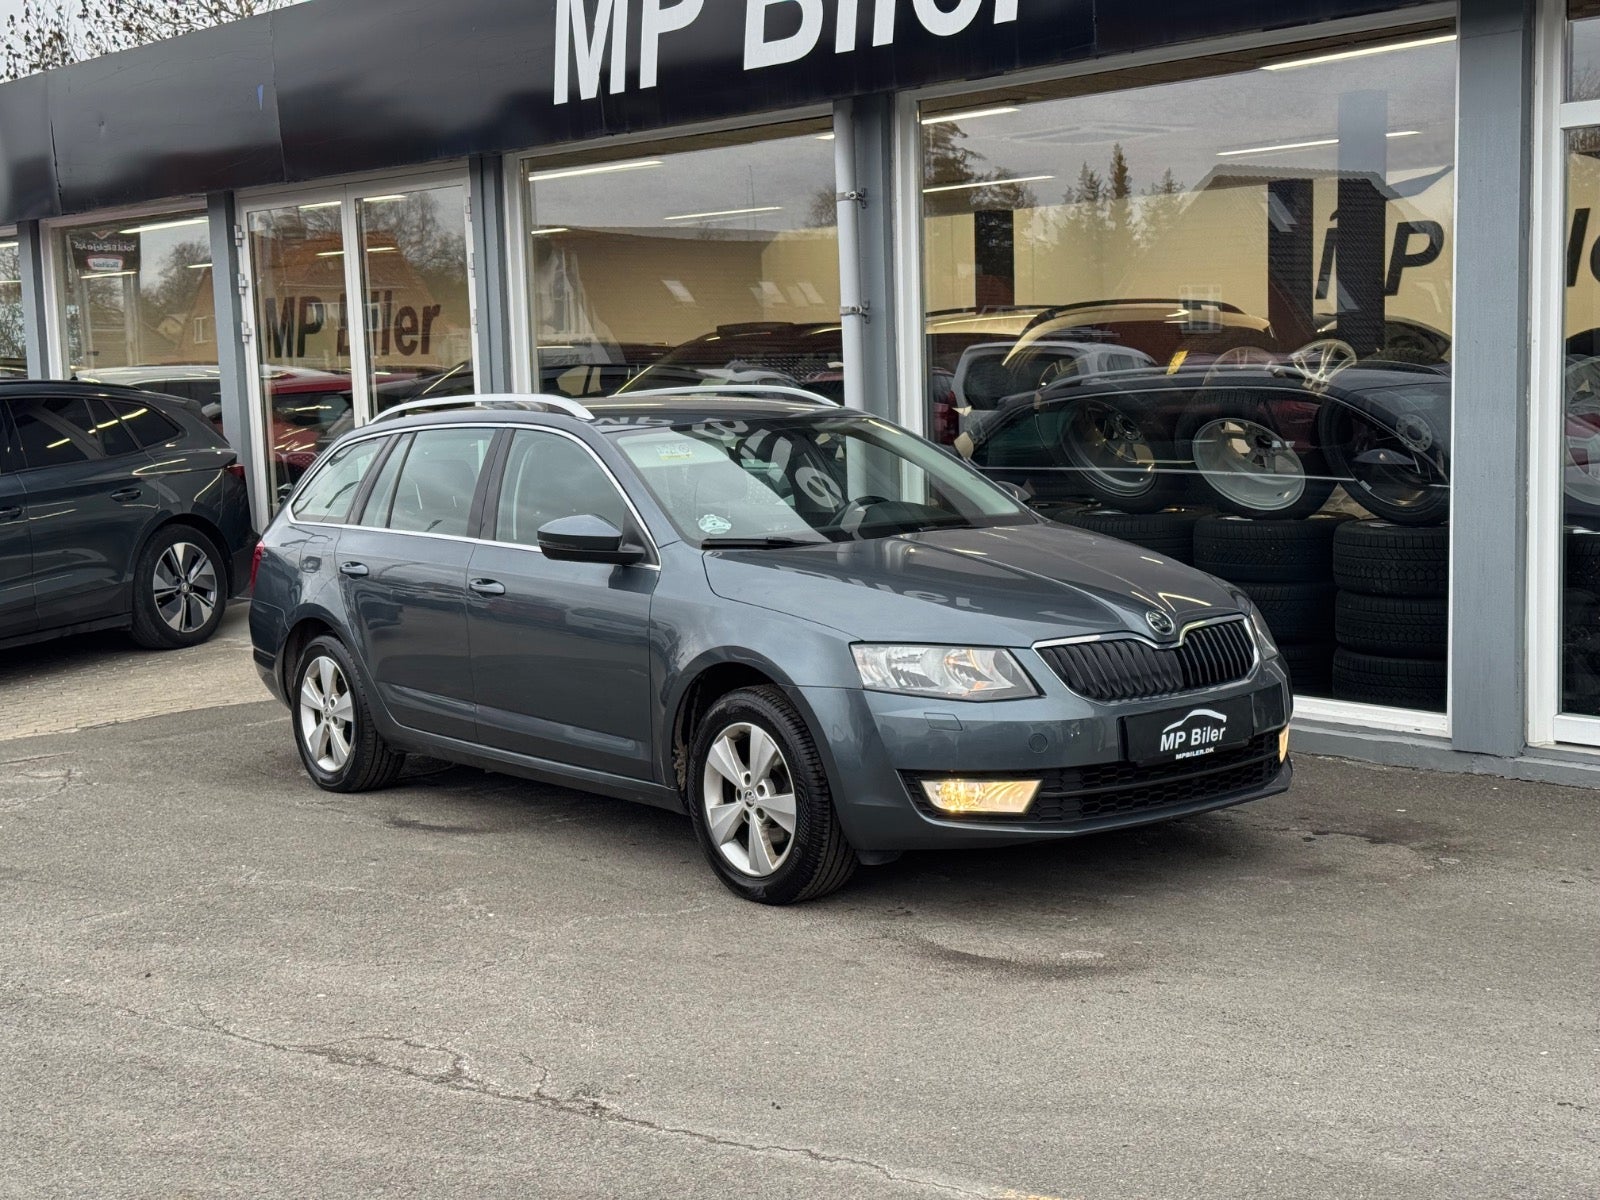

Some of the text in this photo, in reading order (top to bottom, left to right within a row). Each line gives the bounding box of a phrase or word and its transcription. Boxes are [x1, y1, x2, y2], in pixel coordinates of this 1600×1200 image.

[553, 0, 704, 105] MP
[265, 295, 324, 359] MP
[1160, 725, 1226, 752] MP Biler
[1176, 747, 1214, 760] MPBILER.DK
